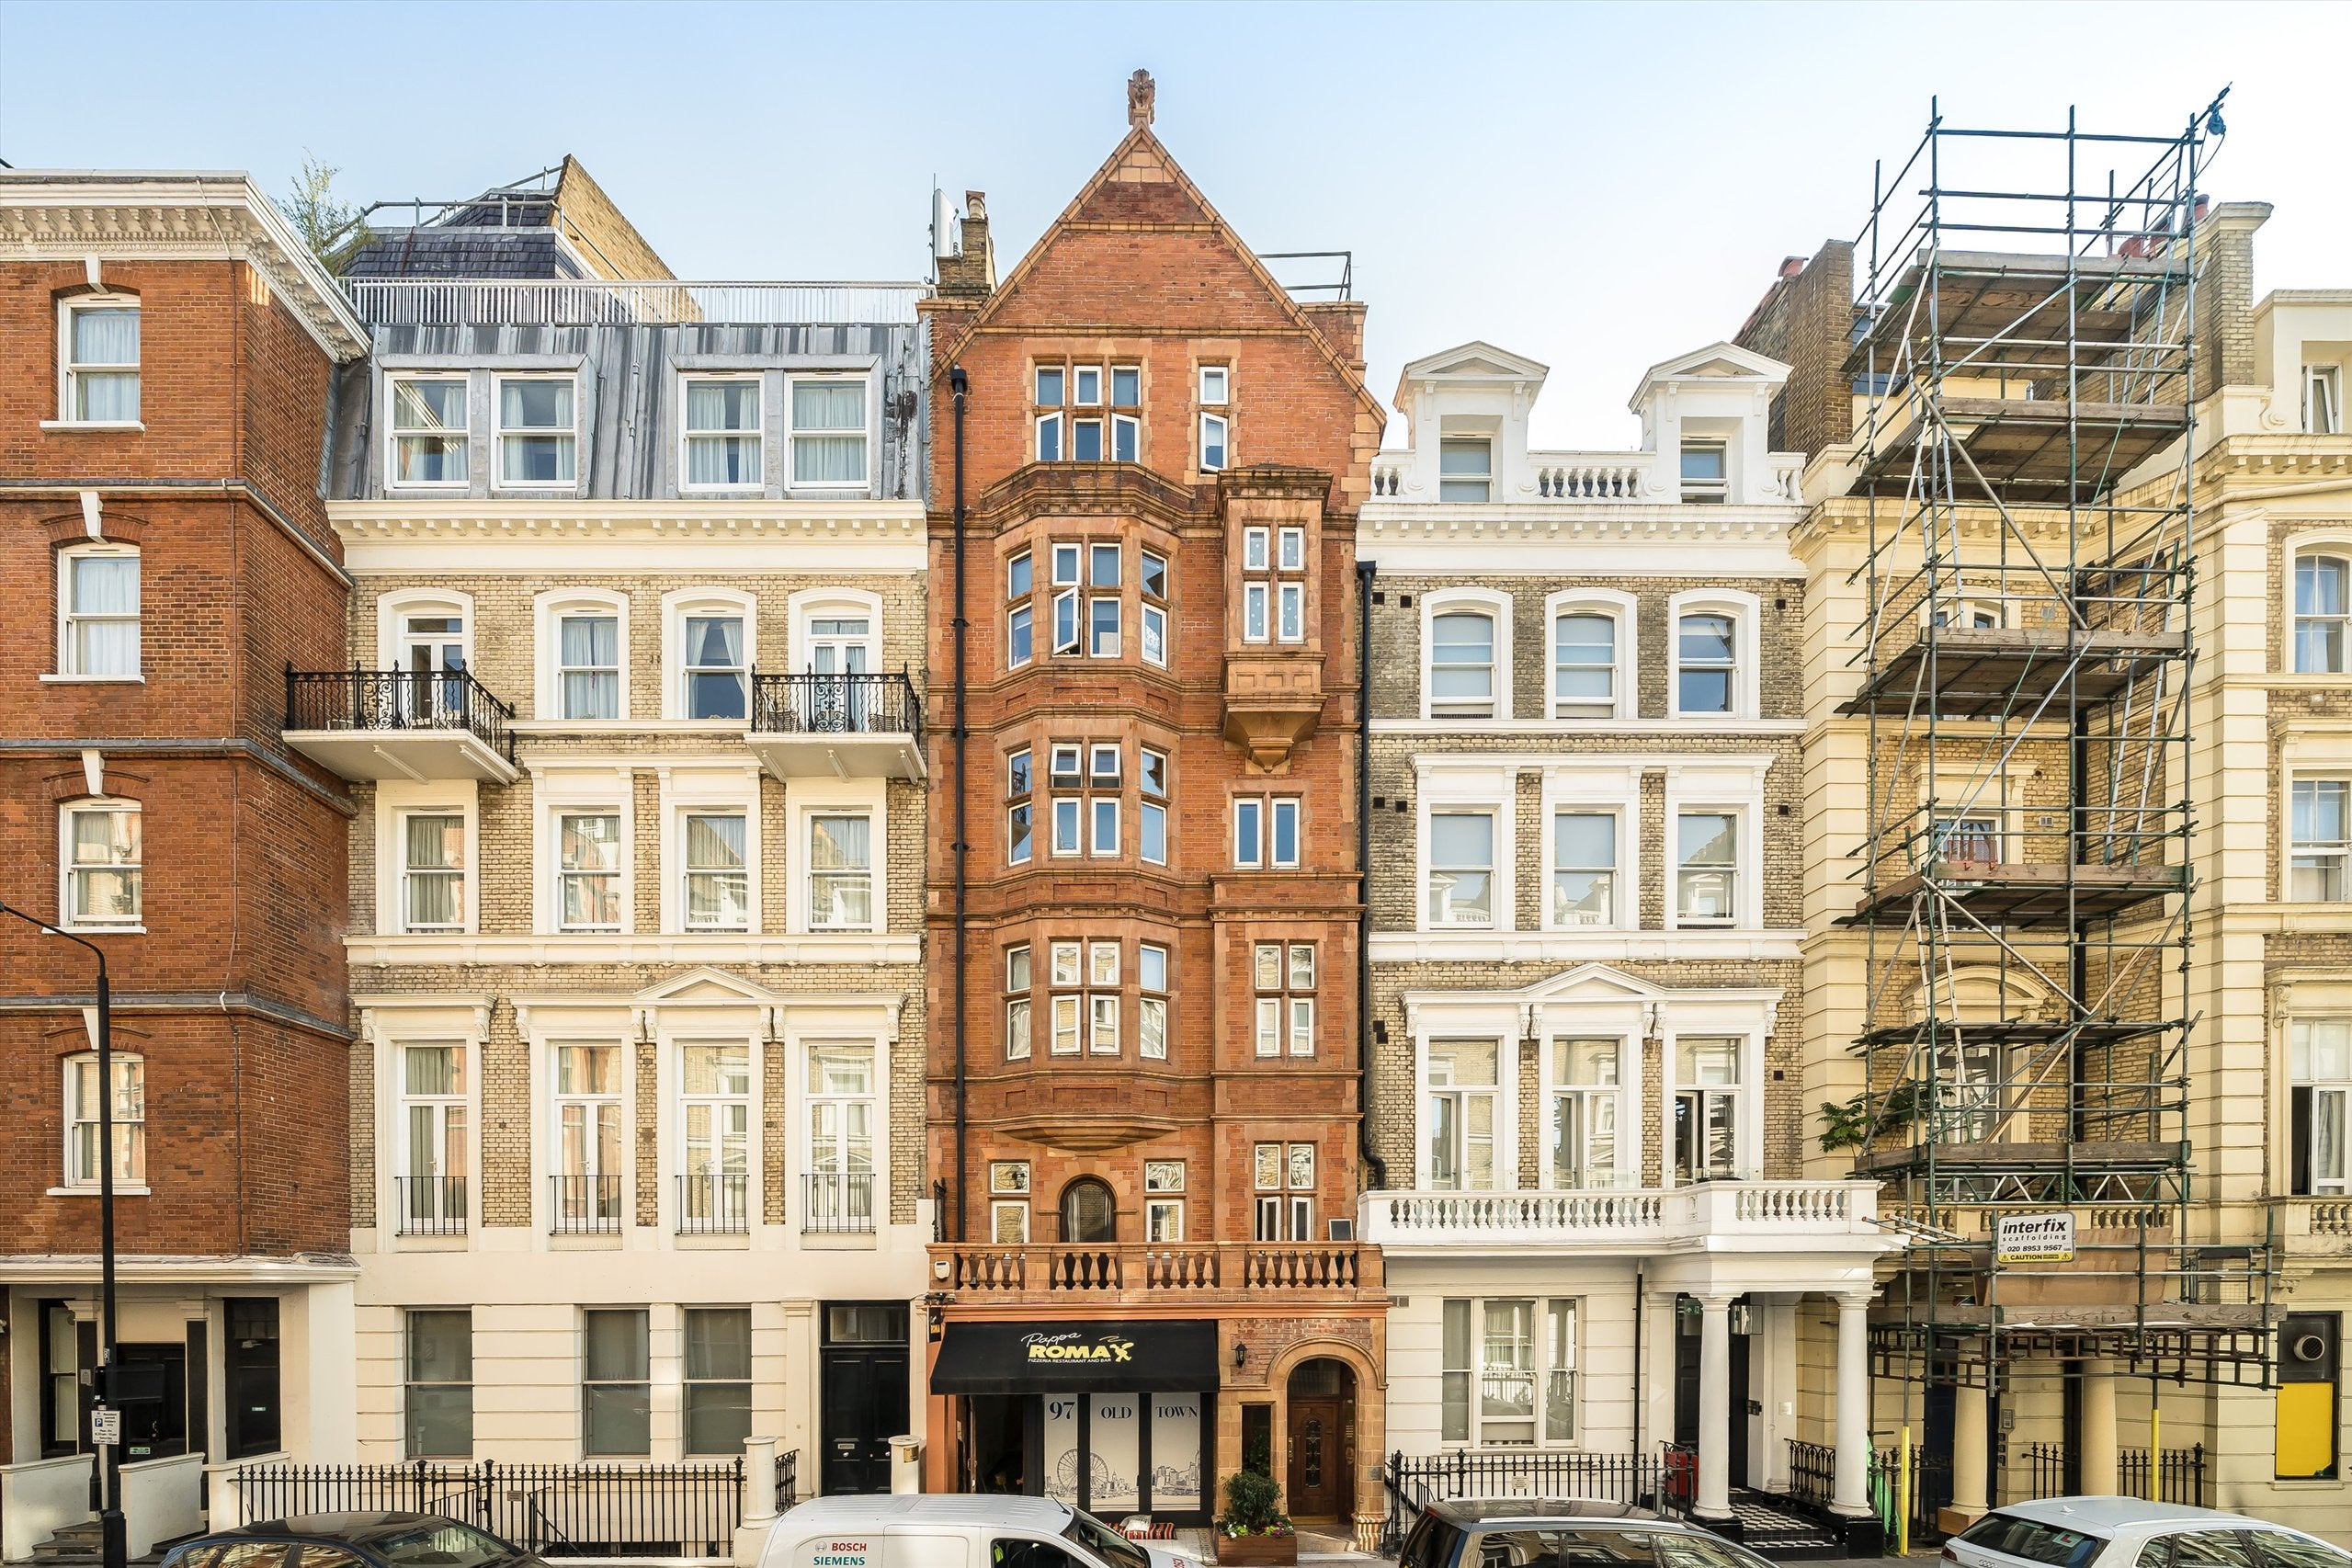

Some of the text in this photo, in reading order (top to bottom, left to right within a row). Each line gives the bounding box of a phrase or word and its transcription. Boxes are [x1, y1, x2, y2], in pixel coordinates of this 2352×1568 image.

[2003, 1218, 2066, 1233] interfix
[2003, 1233, 2066, 1242] scaffolding
[1020, 1332, 1082, 1347] Pappa
[1028, 1345, 1111, 1358] ROMA
[1049, 1401, 1198, 1420] 97 OLD TOWN
[97, 1418, 102, 1426] P
[832, 1543, 867, 1551] BOSCH
[813, 1556, 866, 1566] SIEMENS
